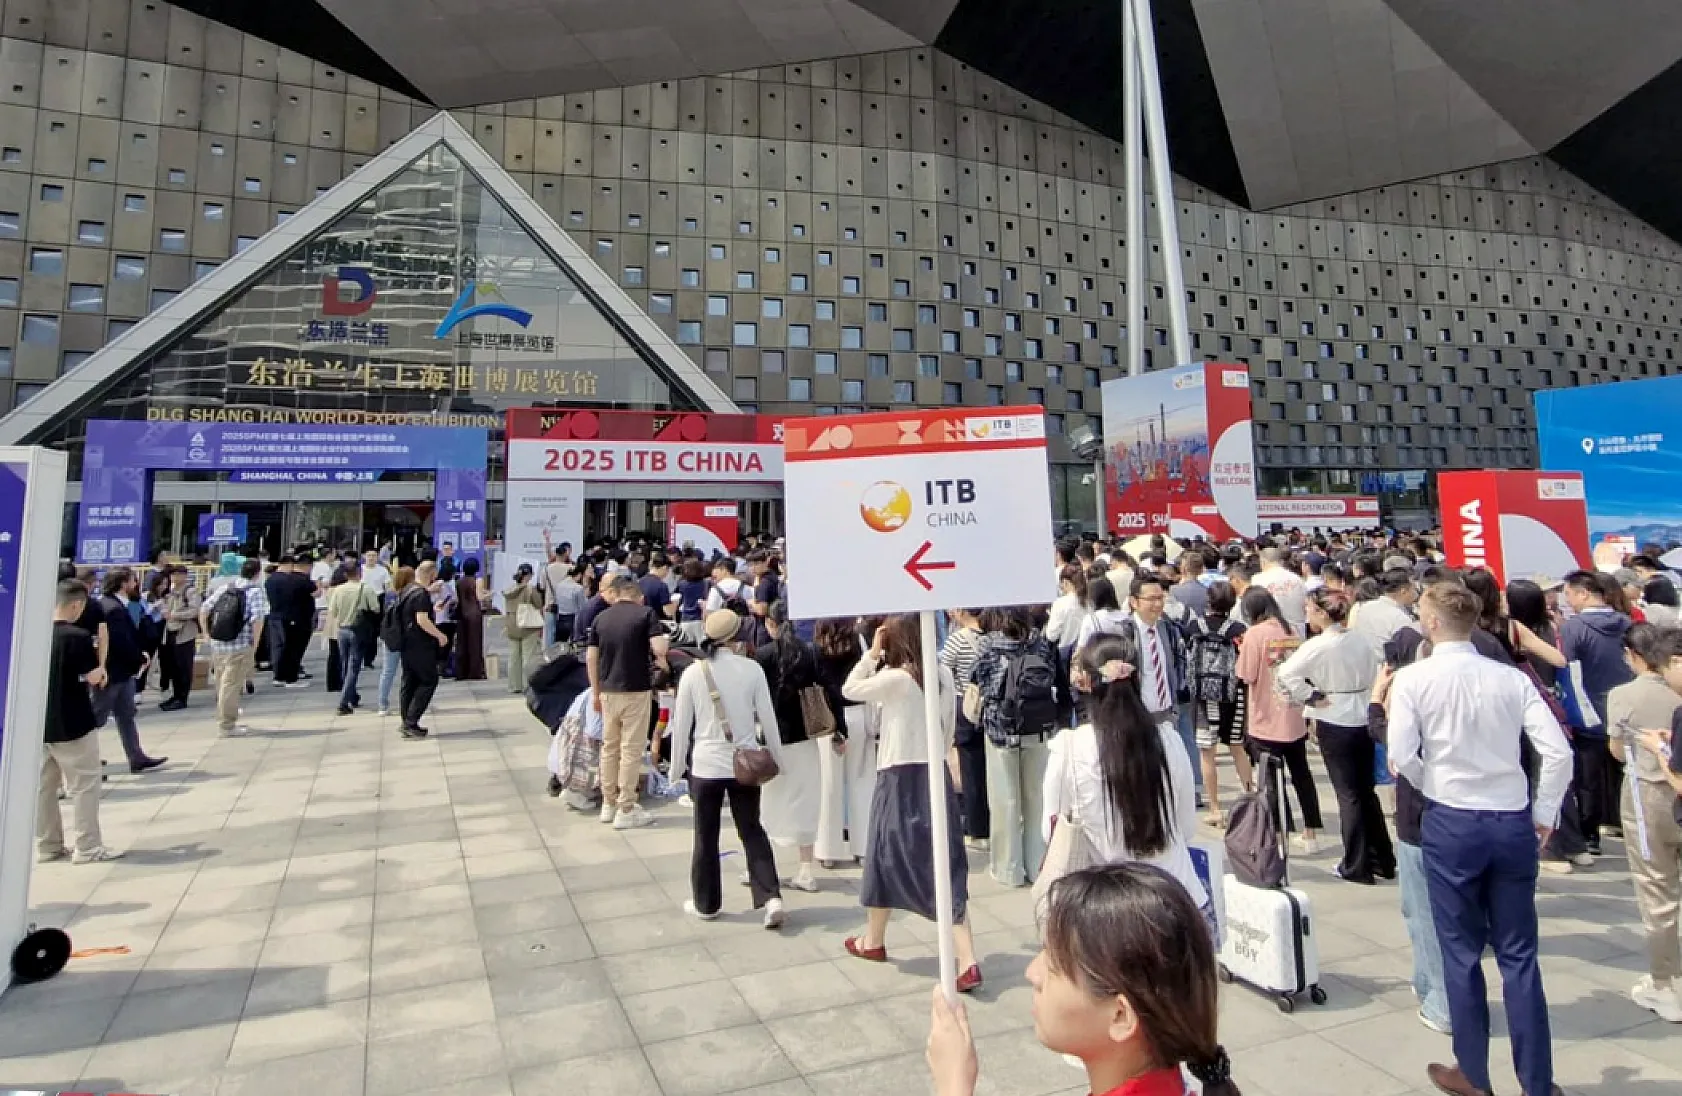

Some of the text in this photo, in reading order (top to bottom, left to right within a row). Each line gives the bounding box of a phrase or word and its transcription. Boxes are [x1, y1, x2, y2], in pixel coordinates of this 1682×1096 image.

[307, 320, 388, 338] 东浩兰生
[453, 332, 554, 348] 上海世博展览馆
[247, 357, 598, 395] 东浩兰生上海世博展览馆
[147, 408, 498, 427] DLG SHANG HAI WORLD EXPO EXHIBITION
[993, 419, 1011, 429] ITB
[544, 449, 763, 473] 2025 ITB CHINA
[297, 472, 328, 481] CHINA
[925, 479, 977, 506] ITB
[926, 511, 978, 528] CHINA
[1118, 512, 1146, 527] 2025
